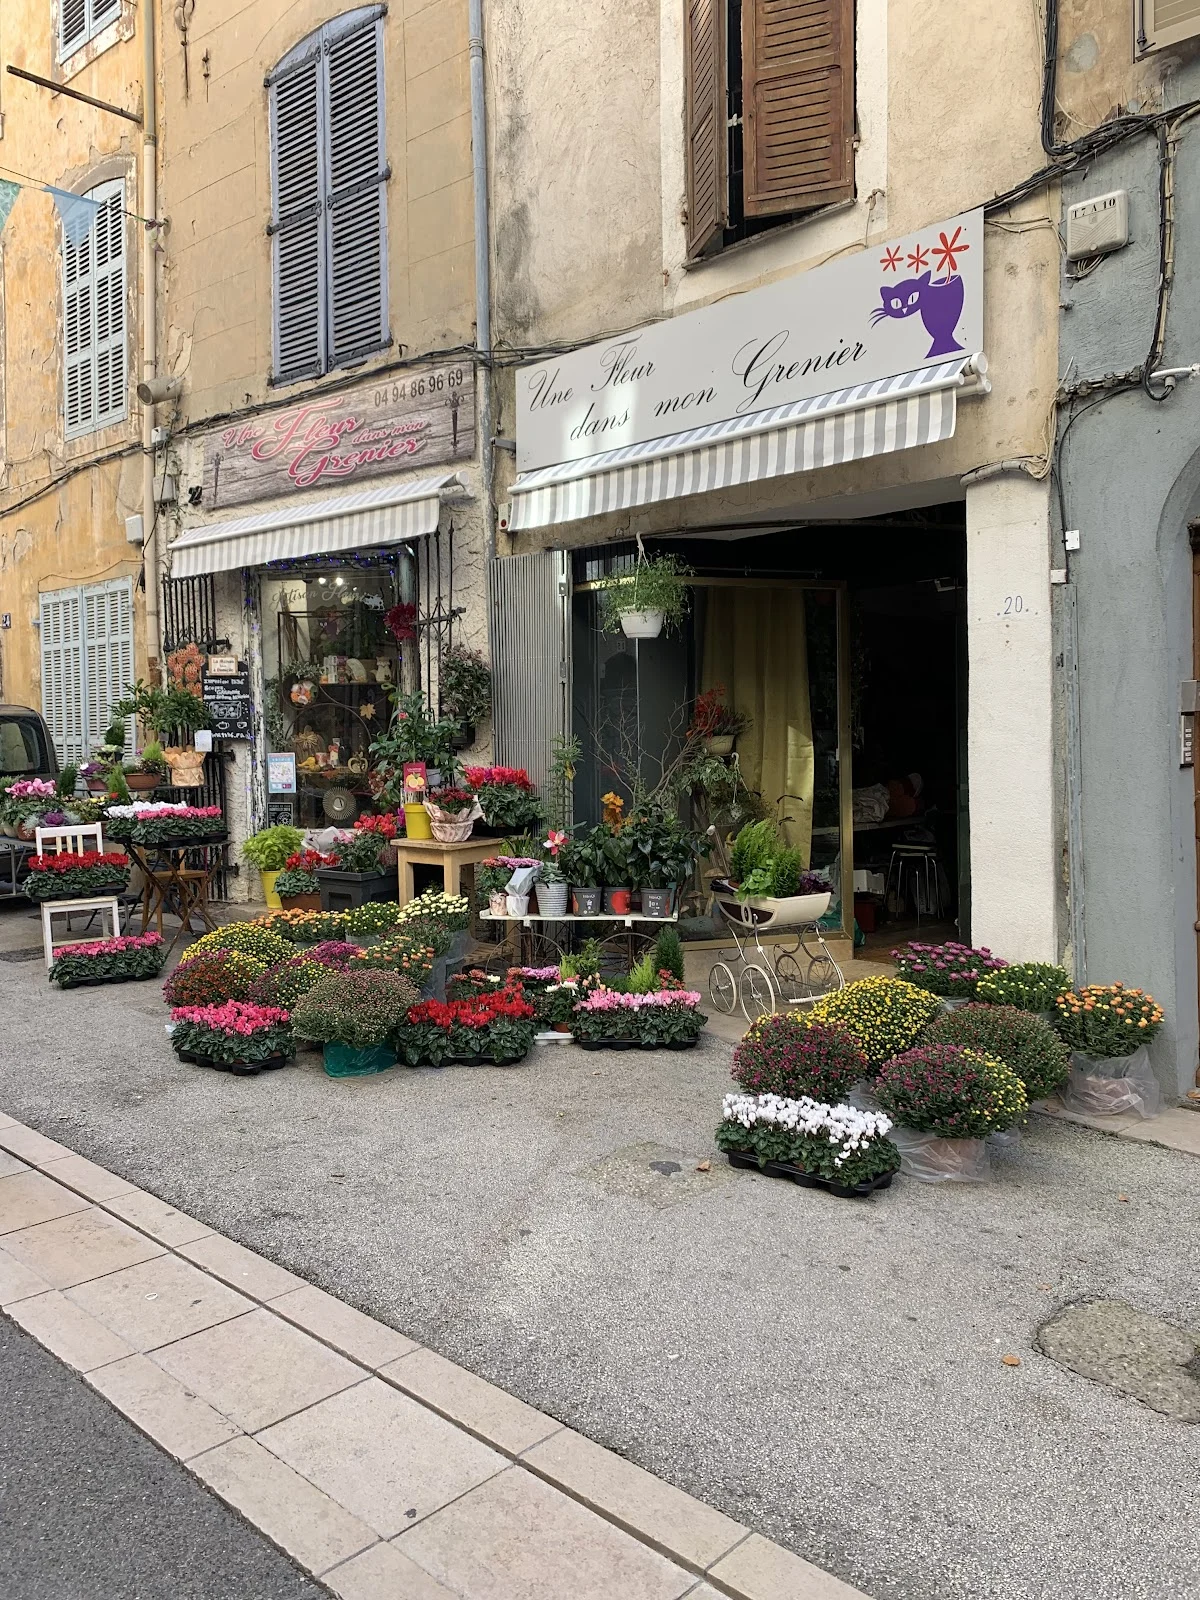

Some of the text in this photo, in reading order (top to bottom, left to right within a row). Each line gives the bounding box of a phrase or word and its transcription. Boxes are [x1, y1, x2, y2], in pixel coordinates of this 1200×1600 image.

[1091, 204, 1097, 212] A
[1103, 198, 1115, 209] 10
[374, 369, 464, 407] 04 94 86 96 69
[528, 334, 656, 412] Une Fleur
[570, 330, 867, 441] dans mon Grenier
[222, 396, 364, 460] Une Fleur
[351, 420, 428, 445] dans mon
[286, 436, 426, 486] Grenier
[1004, 595, 1023, 615] 20
